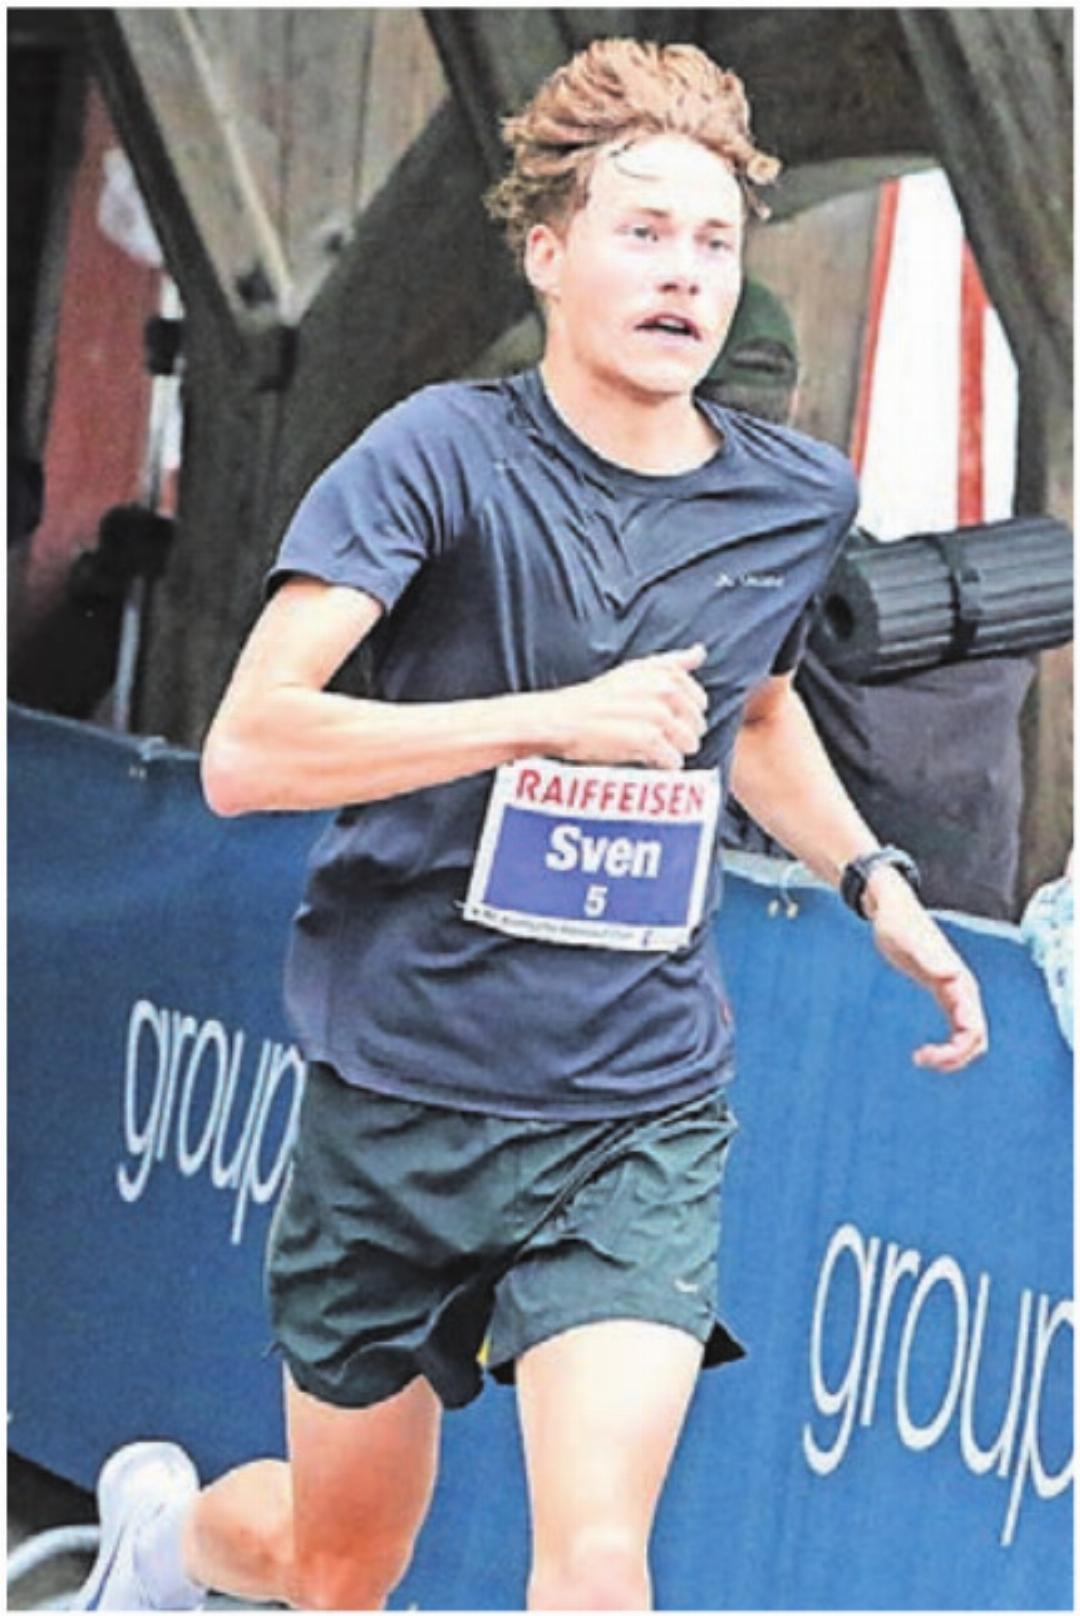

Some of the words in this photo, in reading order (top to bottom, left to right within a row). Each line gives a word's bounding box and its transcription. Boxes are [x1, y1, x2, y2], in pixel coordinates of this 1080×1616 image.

[516, 769, 704, 816] RAIFFEISEN
[545, 824, 662, 878] Sven
[584, 885, 608, 917] 5
[116, 1000, 307, 1245] group
[803, 1222, 1074, 1546] group
